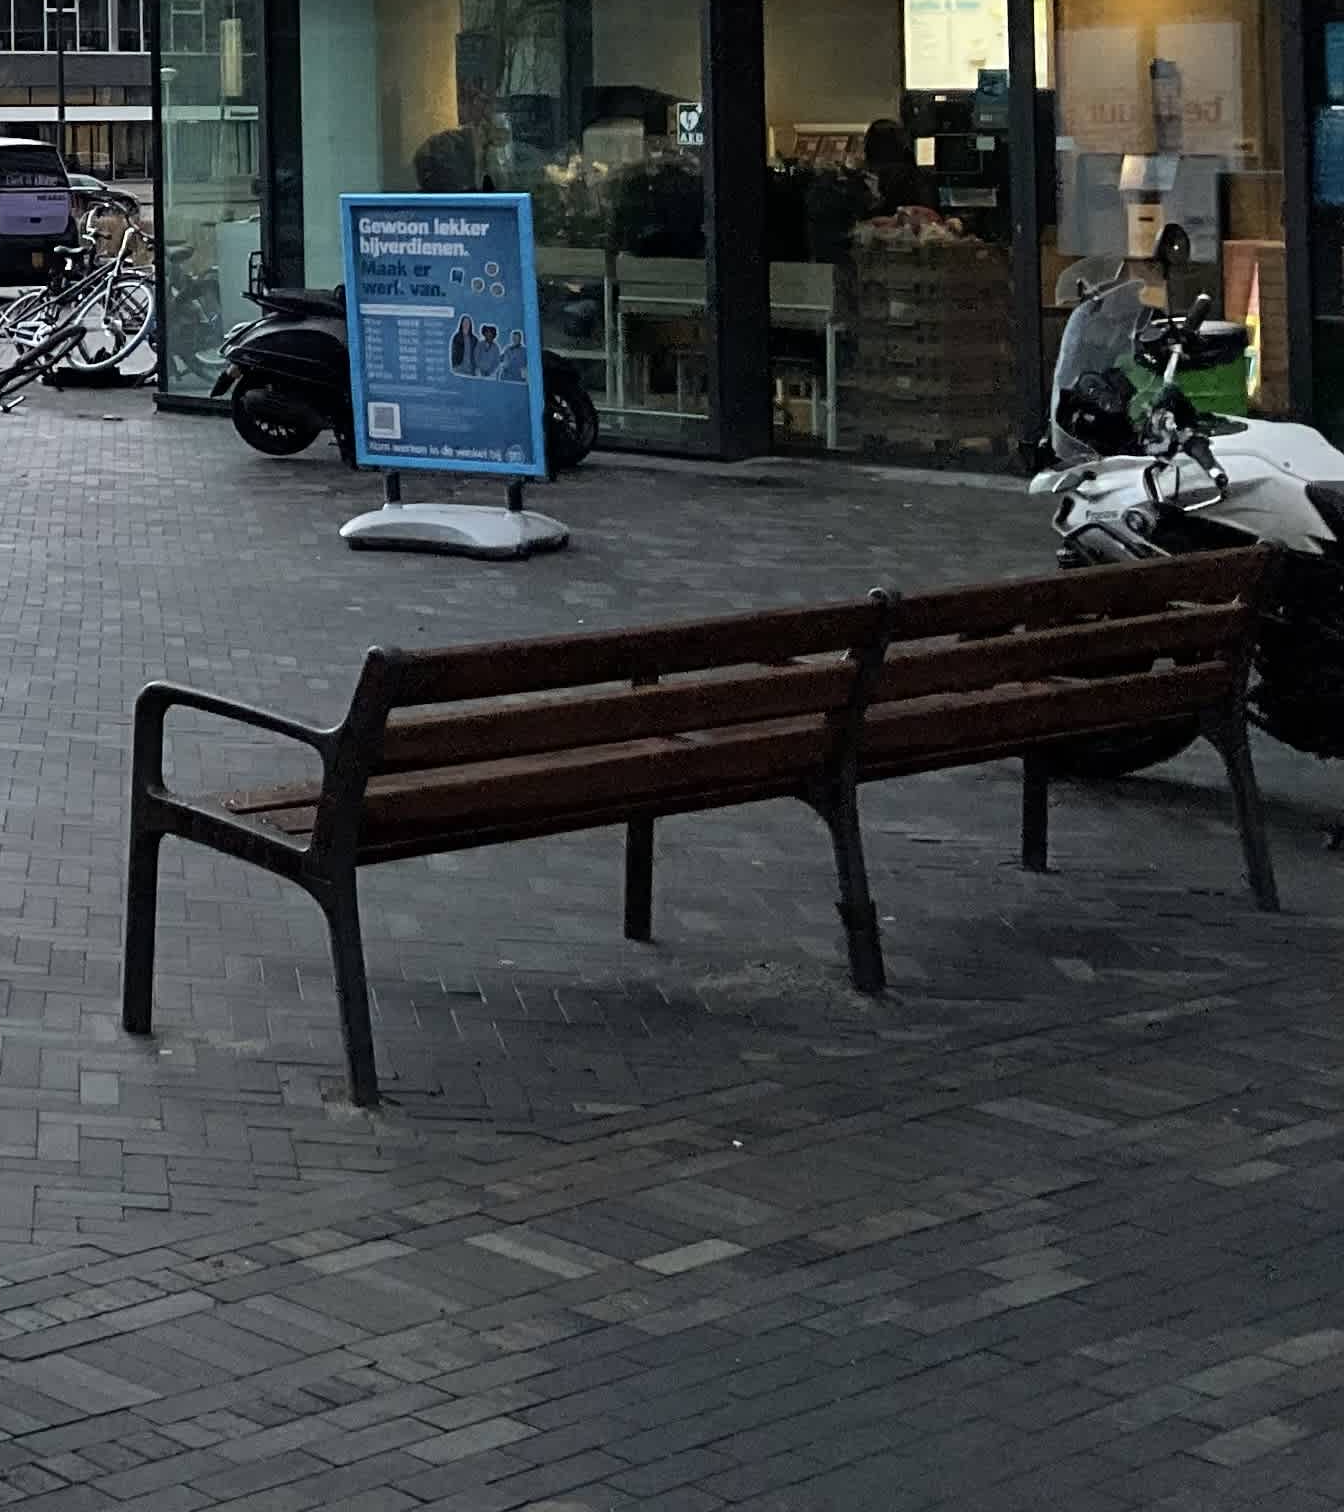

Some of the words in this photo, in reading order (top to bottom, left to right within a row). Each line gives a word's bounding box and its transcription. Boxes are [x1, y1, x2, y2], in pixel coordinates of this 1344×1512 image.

[680, 133, 704, 144] AED
[359, 217, 430, 235] Gewoon
[433, 217, 490, 236] lekker
[359, 236, 471, 258] bijverdienen.
[361, 259, 407, 277] Maak
[413, 265, 433, 278] er
